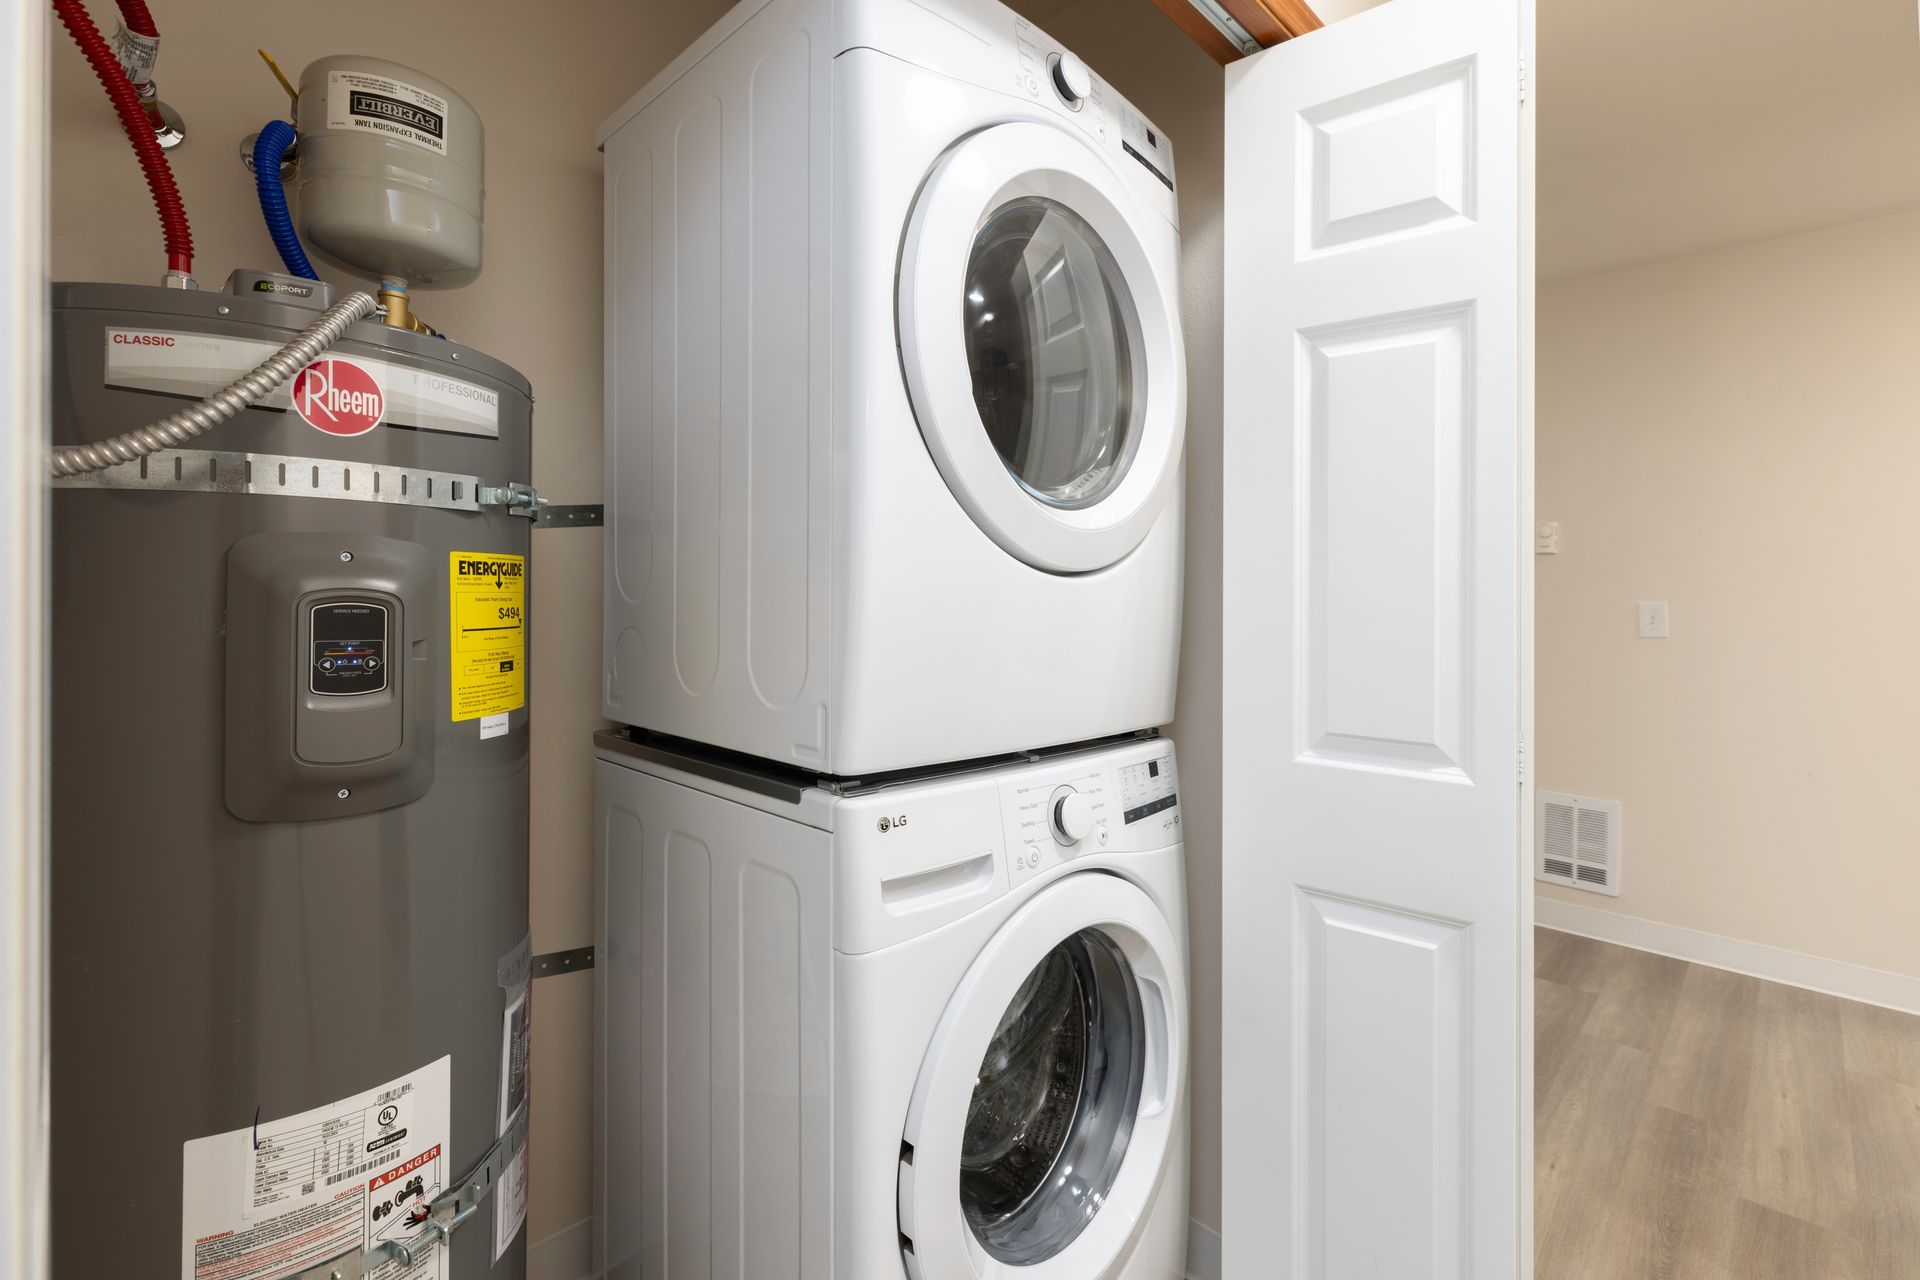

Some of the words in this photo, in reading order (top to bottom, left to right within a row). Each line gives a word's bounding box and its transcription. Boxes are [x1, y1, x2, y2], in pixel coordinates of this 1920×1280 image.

[358, 99, 436, 129] EVERBILT
[354, 118, 372, 128] TANK
[372, 121, 412, 138] EXPANSION
[414, 132, 442, 150] THERMAL
[260, 282, 308, 296] ECOPORT
[113, 334, 175, 347] CLASSIC
[305, 360, 378, 422] Rheem
[414, 374, 497, 407] PROFESSIONAL
[458, 560, 522, 577] ENERGYGUIDE
[892, 815, 907, 828] LG
[382, 1110, 393, 1120] UL
[388, 1148, 437, 1181] DANGER
[334, 1184, 365, 1199] CAUTION
[412, 1197, 427, 1208] HOT
[254, 1216, 279, 1228] ELECTRIC
[280, 1209, 297, 1218] WATER
[298, 1203, 318, 1213] HEATER
[196, 1230, 234, 1244] WARNING
